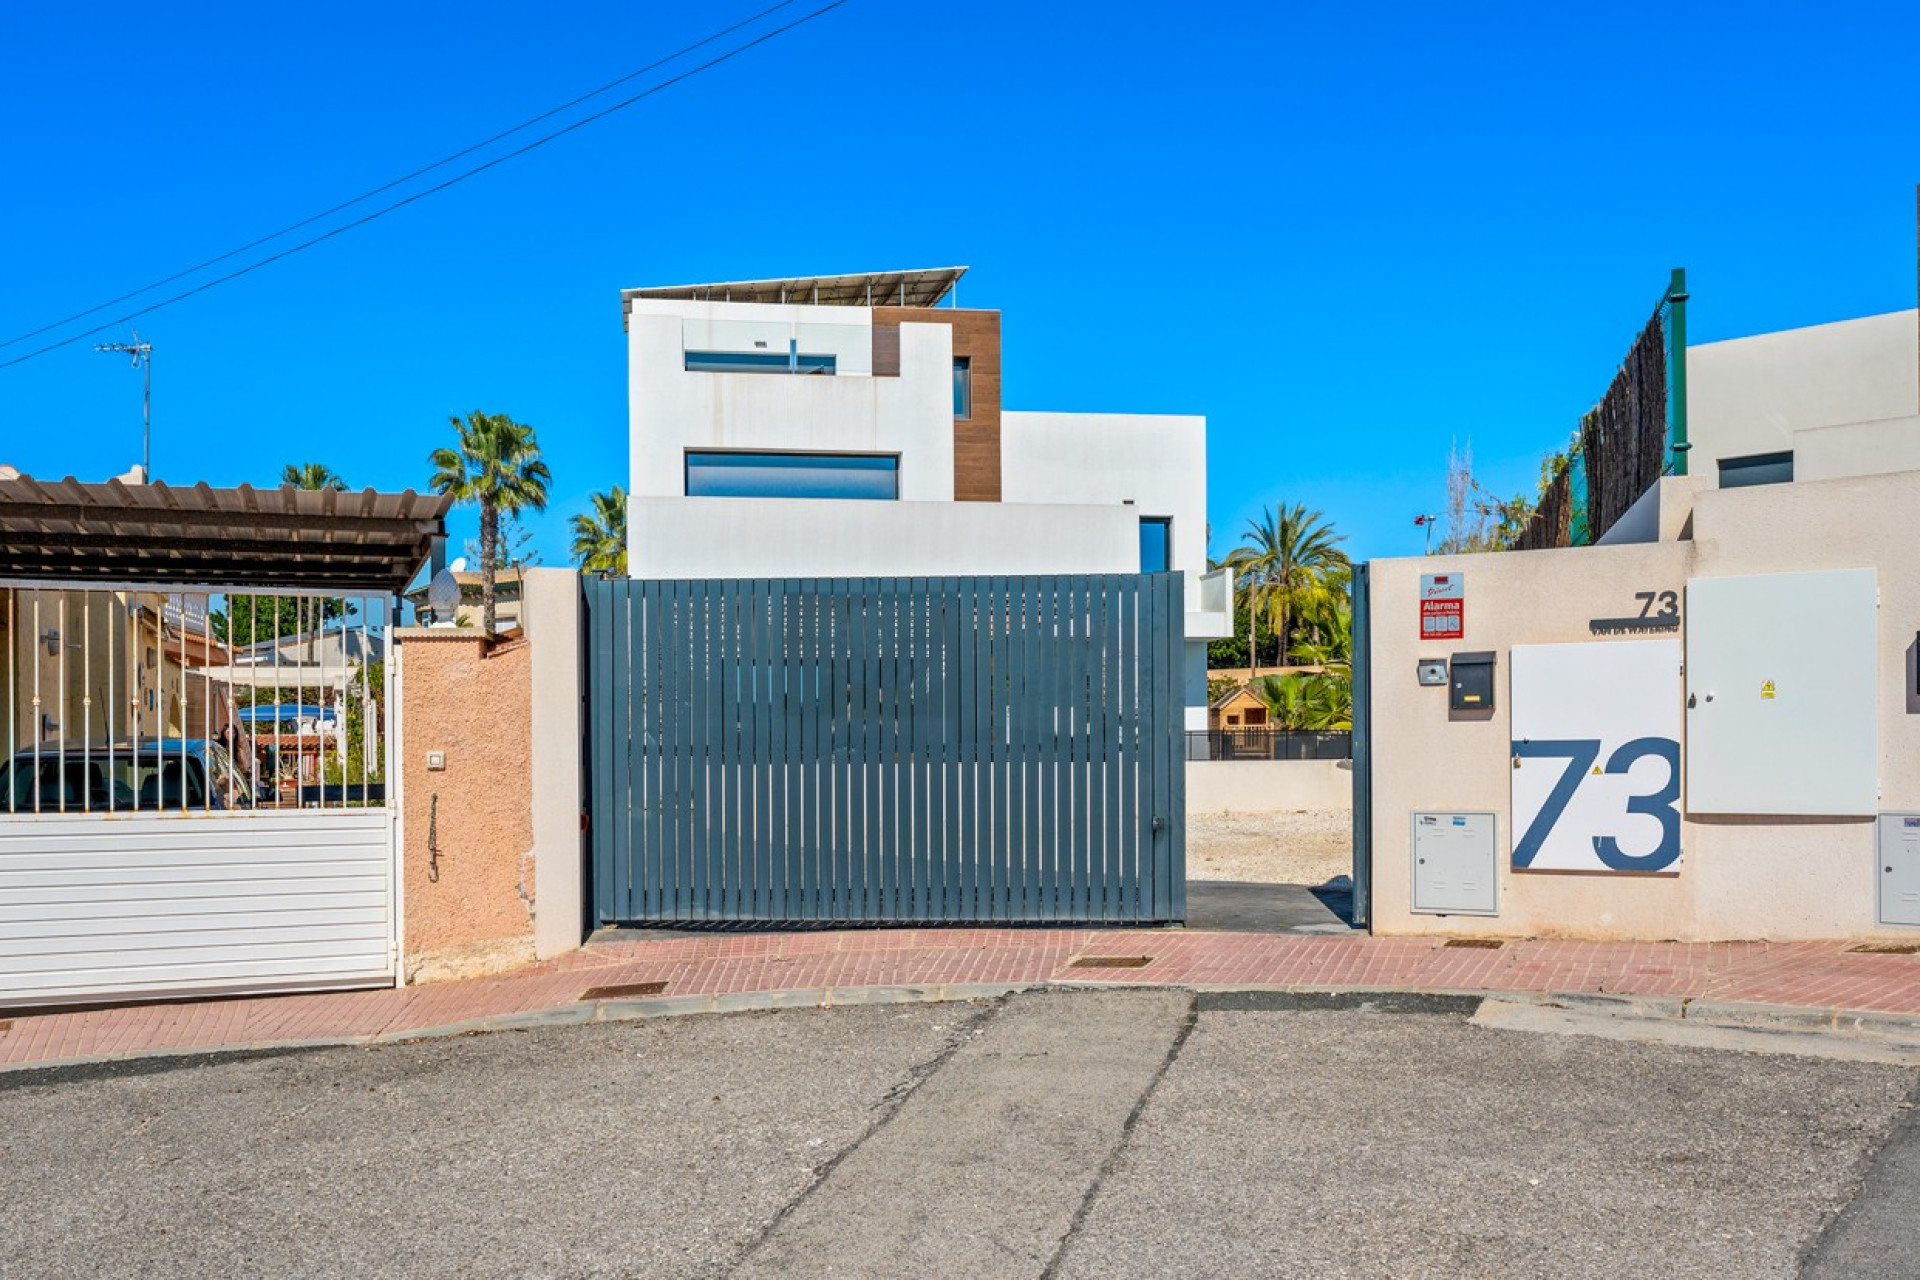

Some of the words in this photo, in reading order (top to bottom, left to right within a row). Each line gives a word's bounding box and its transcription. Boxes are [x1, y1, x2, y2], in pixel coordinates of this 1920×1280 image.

[1423, 601, 1460, 611] Alarma
[1635, 590, 1679, 618] 73
[1511, 737, 1681, 872] 73
